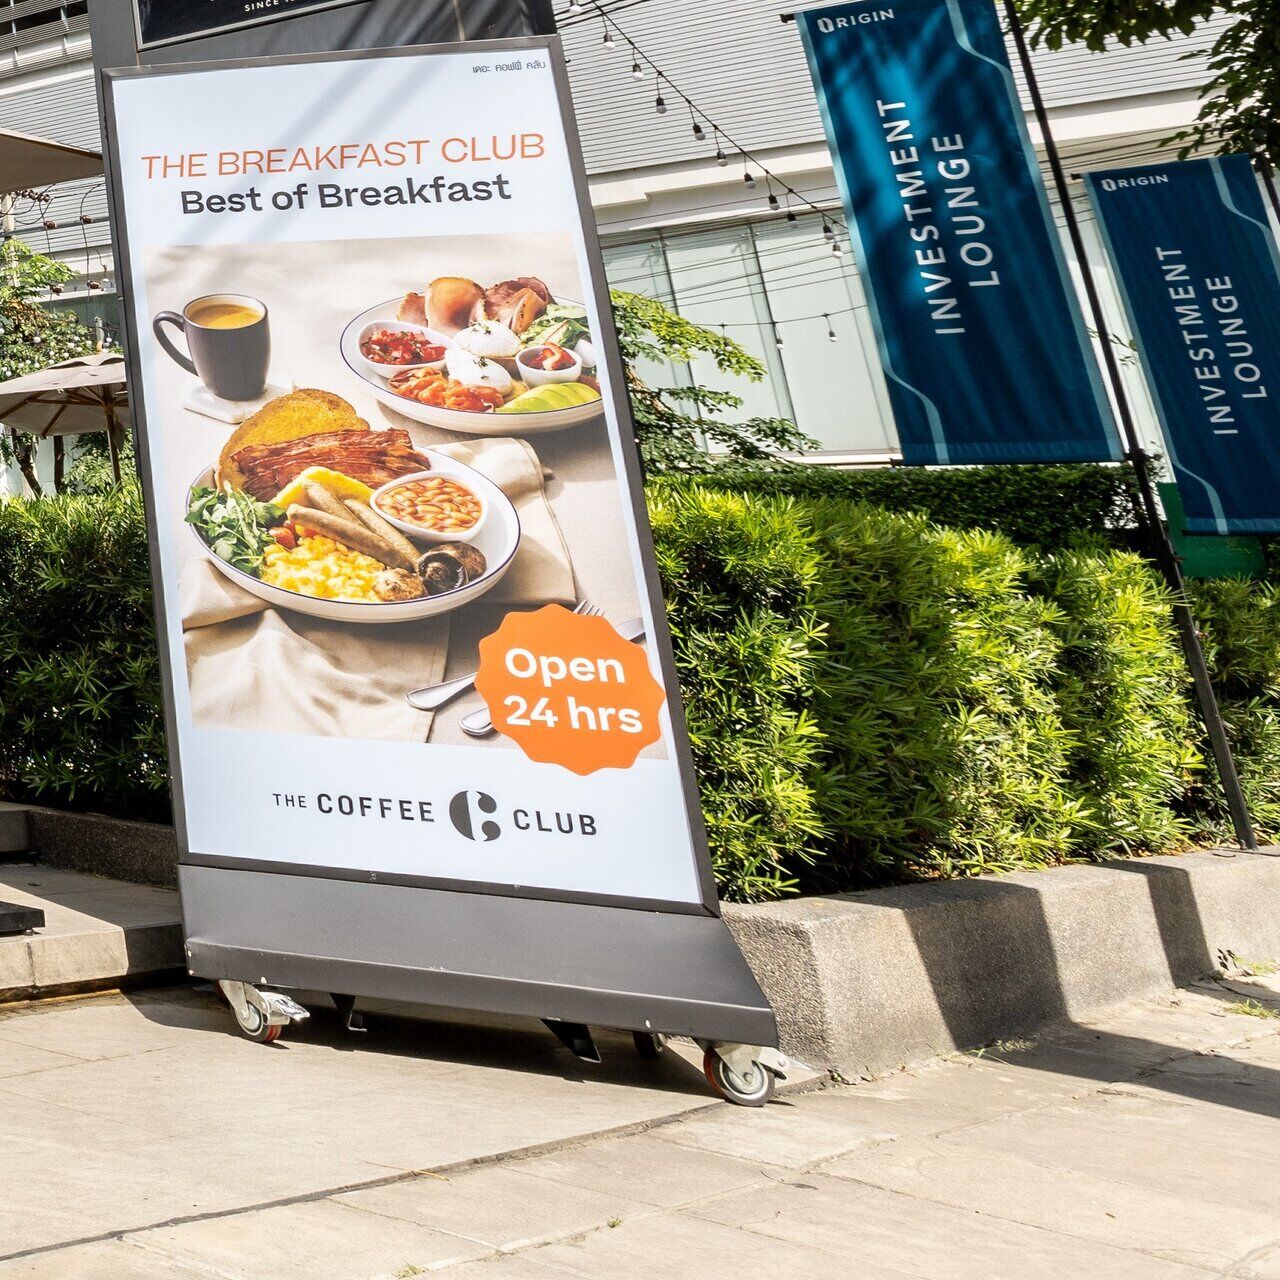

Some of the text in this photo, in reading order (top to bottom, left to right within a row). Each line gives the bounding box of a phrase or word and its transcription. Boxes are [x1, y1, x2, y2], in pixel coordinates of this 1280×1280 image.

[141, 133, 546, 180] THE BREAKFAST CLUB
[180, 173, 512, 215] Best of Breakfast
[876, 98, 966, 335] INVESTMENT
[933, 133, 1000, 288] LOUNGE
[1156, 247, 1239, 436] INVESTMENT
[1205, 275, 1269, 400] LOUNGE
[504, 647, 625, 687] Open
[502, 695, 643, 734] 24 hrs
[272, 792, 307, 809] THE
[317, 793, 435, 823] COFFEE
[513, 808, 597, 836] CLUB
